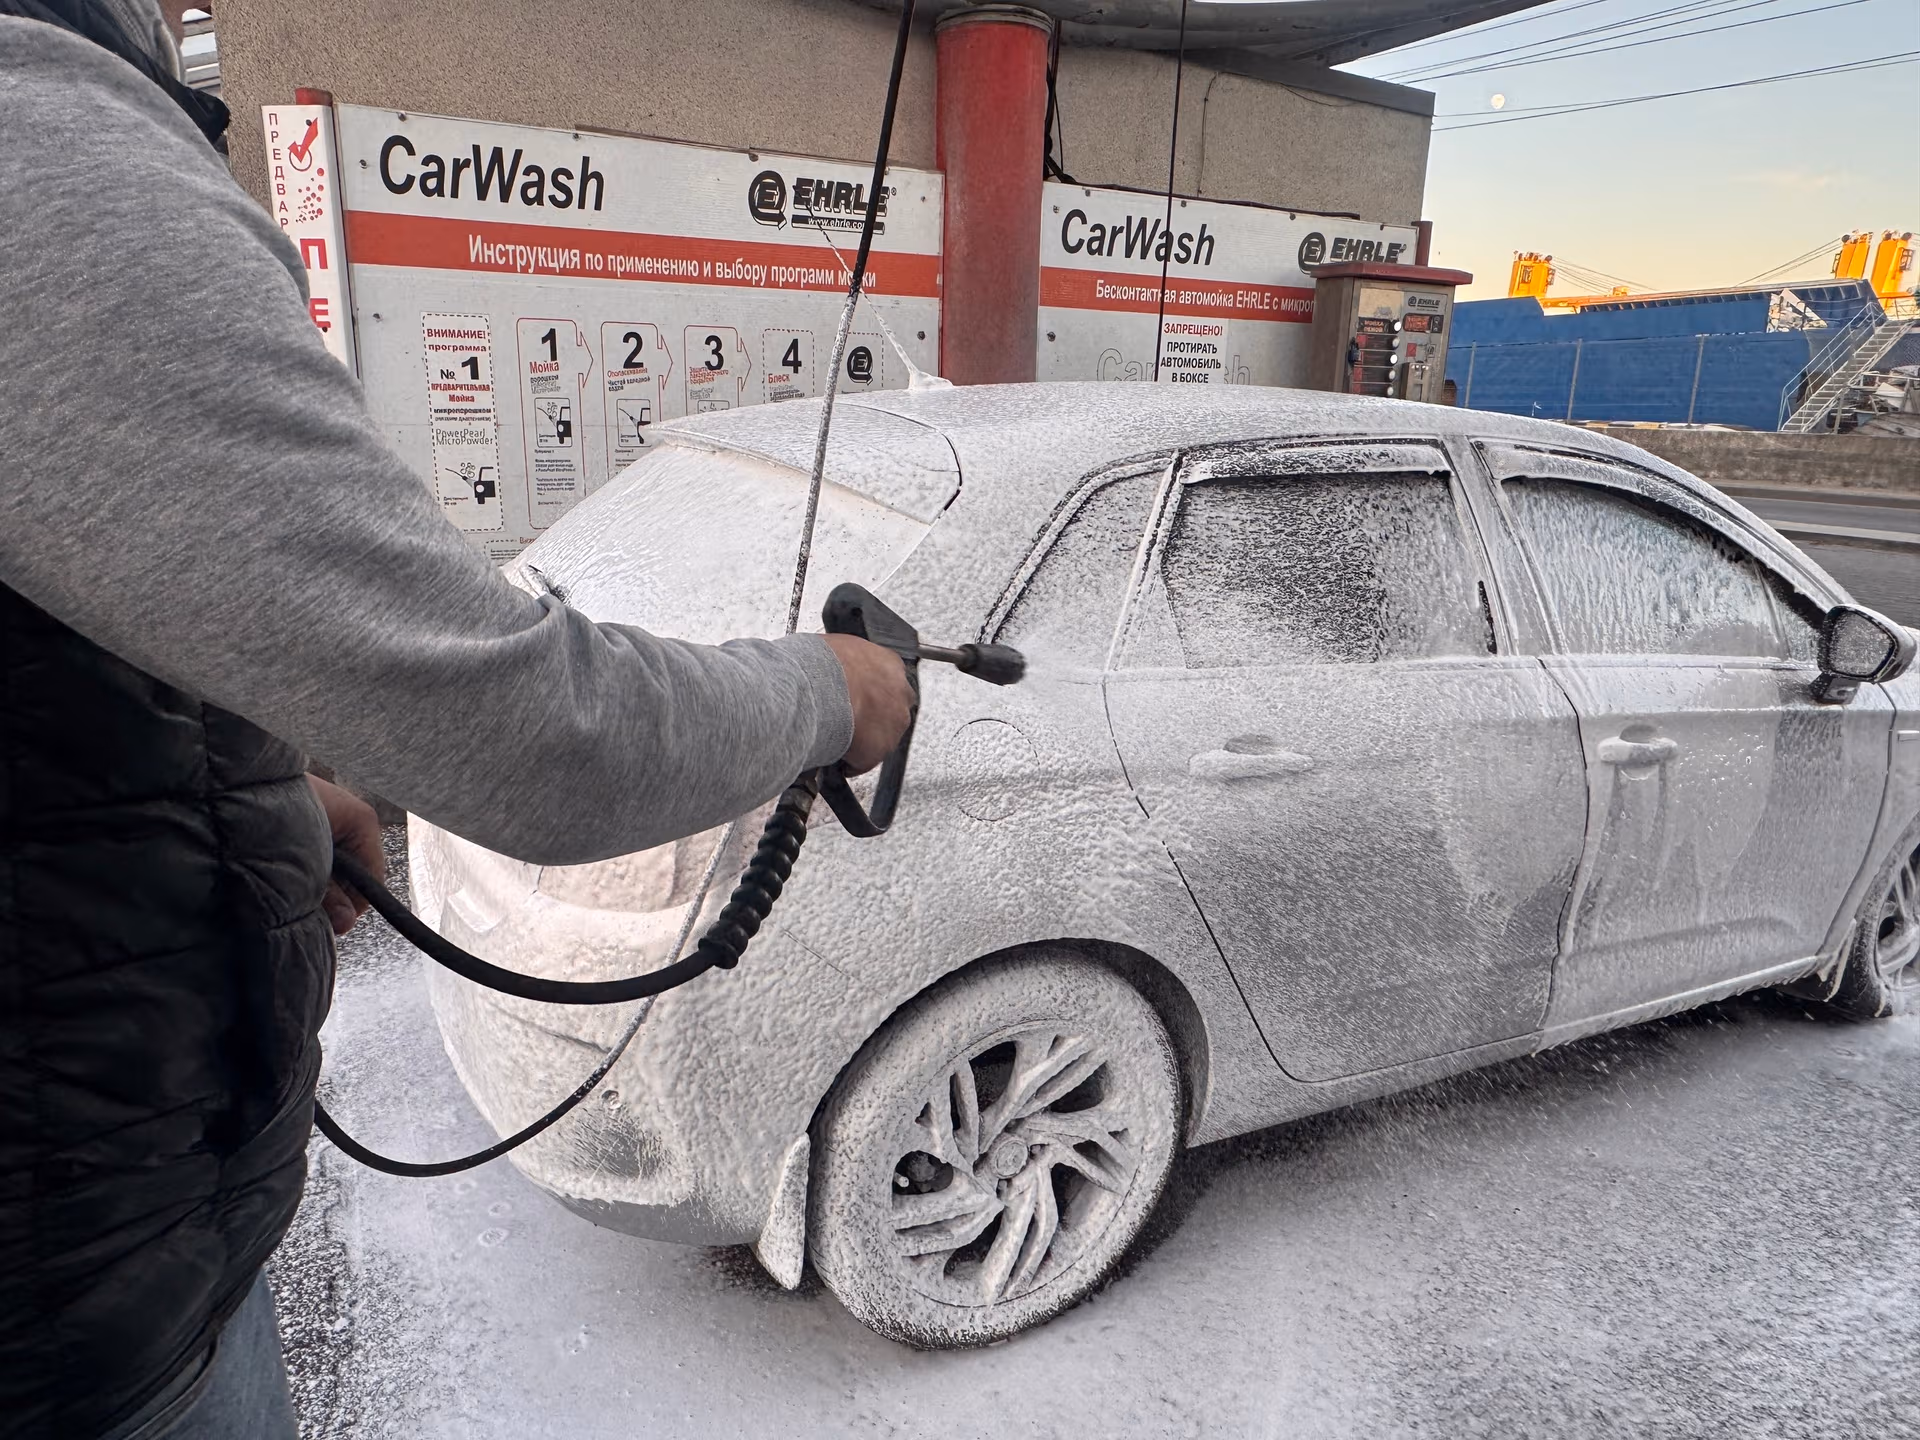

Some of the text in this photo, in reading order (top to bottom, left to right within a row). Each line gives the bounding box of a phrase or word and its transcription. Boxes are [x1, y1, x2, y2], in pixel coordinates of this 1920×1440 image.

[379, 134, 604, 211] CarWash
[808, 217, 865, 231] www.ehrle.co
[1061, 209, 1215, 266] CarWash
[468, 234, 876, 288] Инструкция по применению и выбору программ моки
[1096, 279, 1177, 304] Бесконтактная
[1179, 288, 1234, 308] автомойка
[1236, 290, 1271, 310] EHRLE
[1272, 296, 1279, 311] с
[426, 328, 486, 339] ВНИМАНИЕ!
[1164, 322, 1223, 337] ЗАПРЕЩЕНО!
[428, 343, 487, 352] программа
[541, 327, 557, 362] 1
[622, 331, 644, 369] 2
[1166, 341, 1218, 354] ПРОТИРАТЬ
[704, 335, 725, 371] 3
[782, 338, 802, 374] 4
[440, 356, 479, 380] № 1
[529, 361, 559, 374] Мойка
[1160, 356, 1222, 370] АВТОМОБИЛЬ
[768, 373, 790, 383] Блеск
[1171, 372, 1209, 384] В БОКСЕ
[431, 383, 490, 391] ПРЕДВАРИТЕЛЬНАЯ
[448, 394, 475, 402] Мойка
